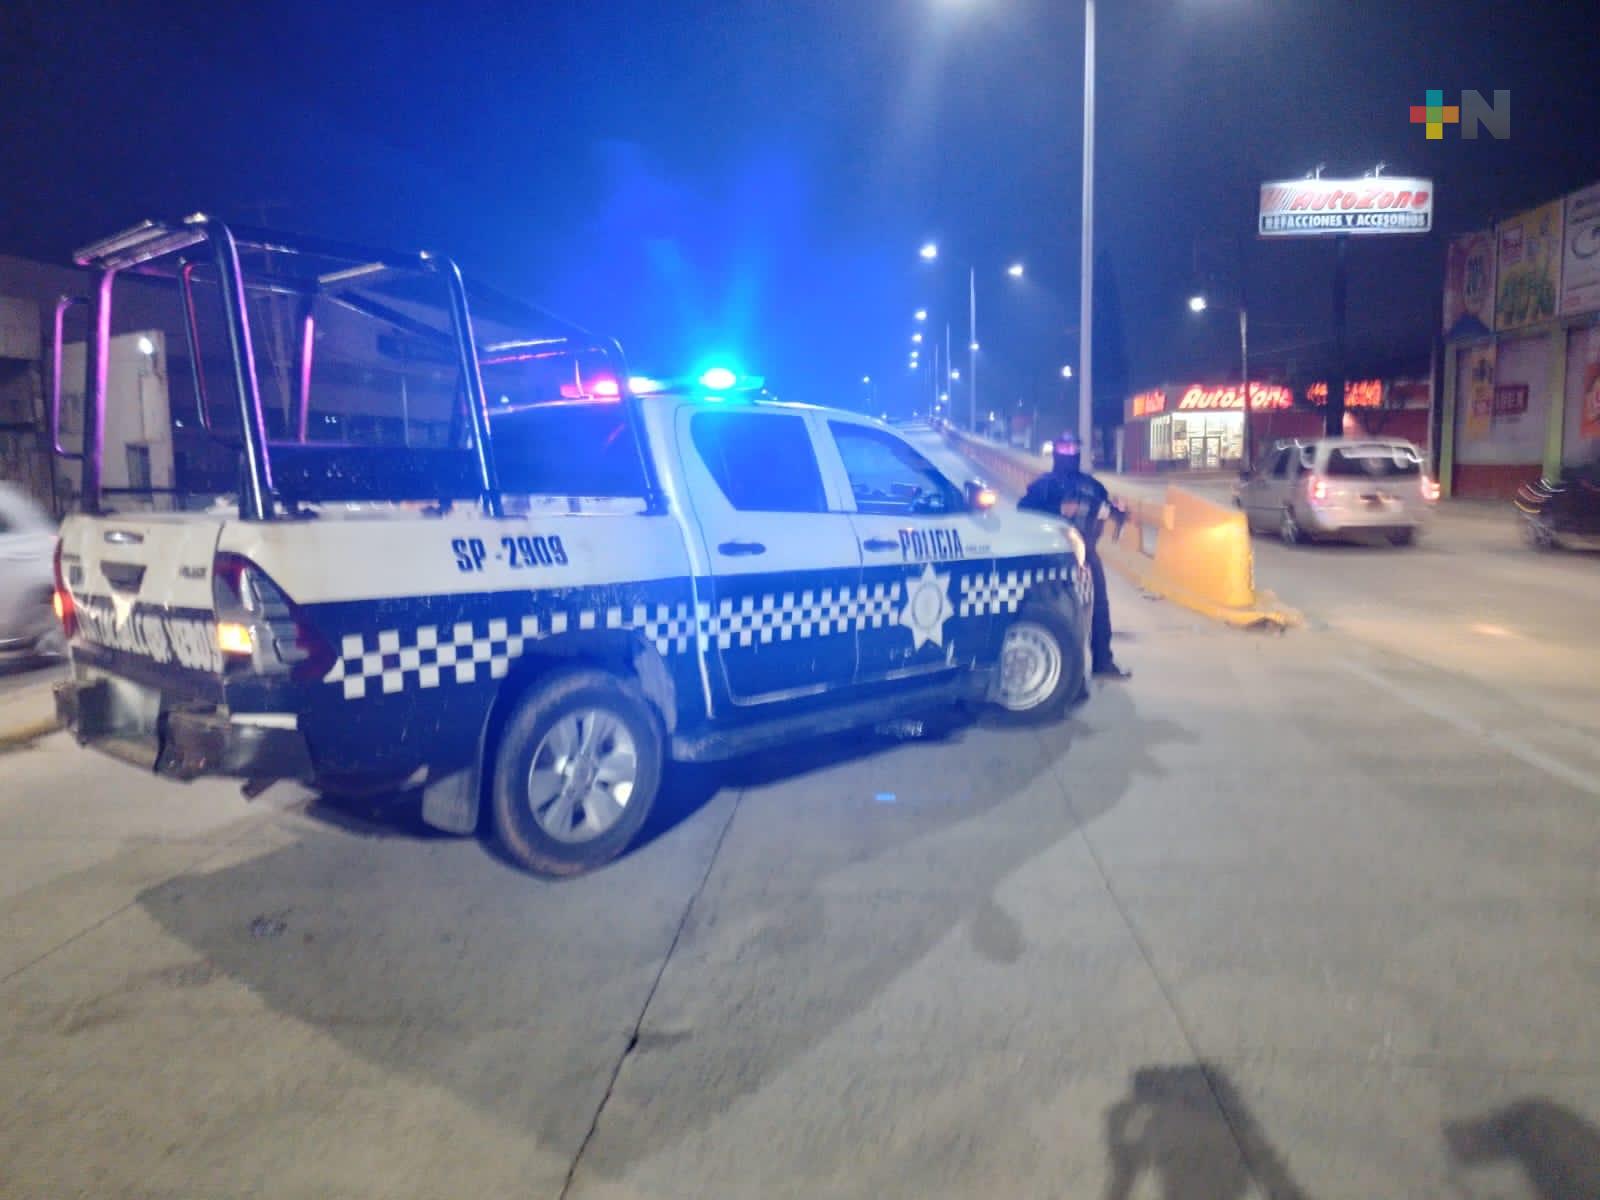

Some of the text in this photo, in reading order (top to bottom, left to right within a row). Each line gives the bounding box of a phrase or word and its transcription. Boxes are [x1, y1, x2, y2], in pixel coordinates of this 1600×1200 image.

[1290, 188, 1430, 211] AutoZone
[1264, 213, 1343, 230] REFACCIONES
[1345, 214, 1355, 227] Y
[1179, 382, 1294, 410] AutoZone
[898, 527, 965, 562] POLICIA
